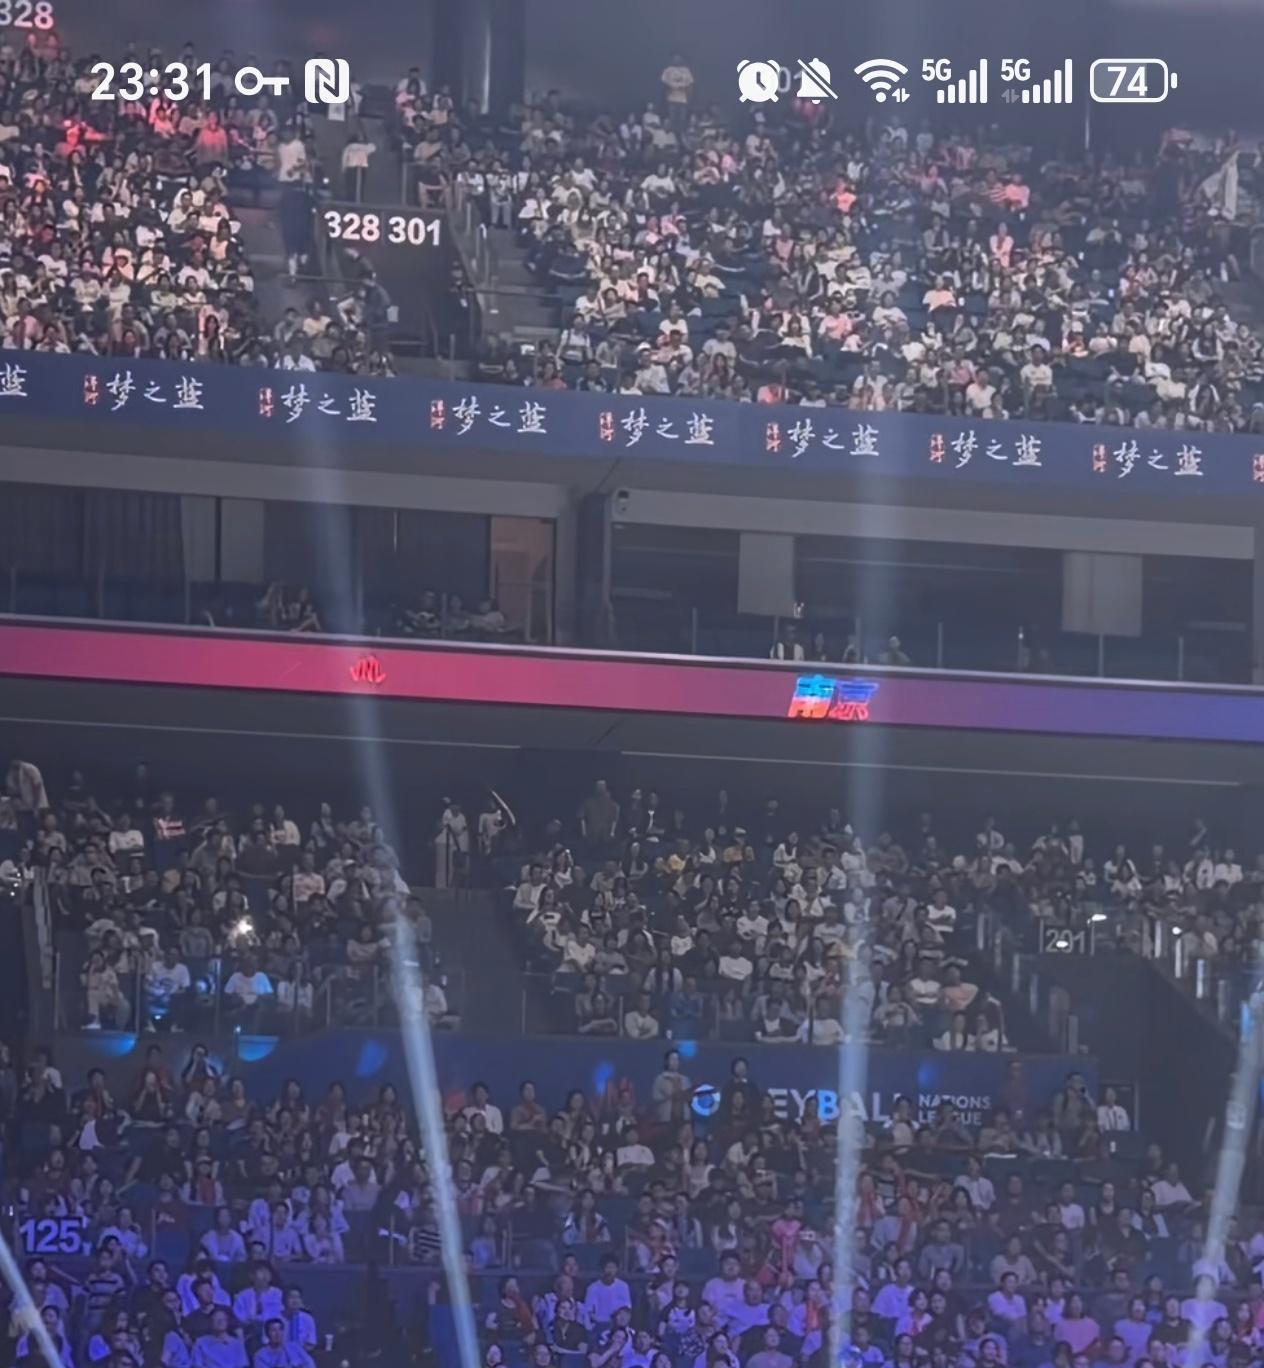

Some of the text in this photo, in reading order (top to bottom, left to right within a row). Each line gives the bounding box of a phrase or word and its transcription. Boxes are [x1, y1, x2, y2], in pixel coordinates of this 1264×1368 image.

[324, 211, 440, 246] 328 301
[106, 370, 204, 411] 梦之蓝
[280, 383, 377, 423] 梦之蓝
[452, 395, 547, 435] 梦之蓝
[620, 407, 714, 447] 梦之蓝
[787, 418, 880, 458] 梦之蓝
[950, 430, 1042, 468] 梦之蓝
[1113, 440, 1203, 478] 梦之蓝
[1045, 929, 1085, 953] 201
[20, 1219, 81, 1253] 125
